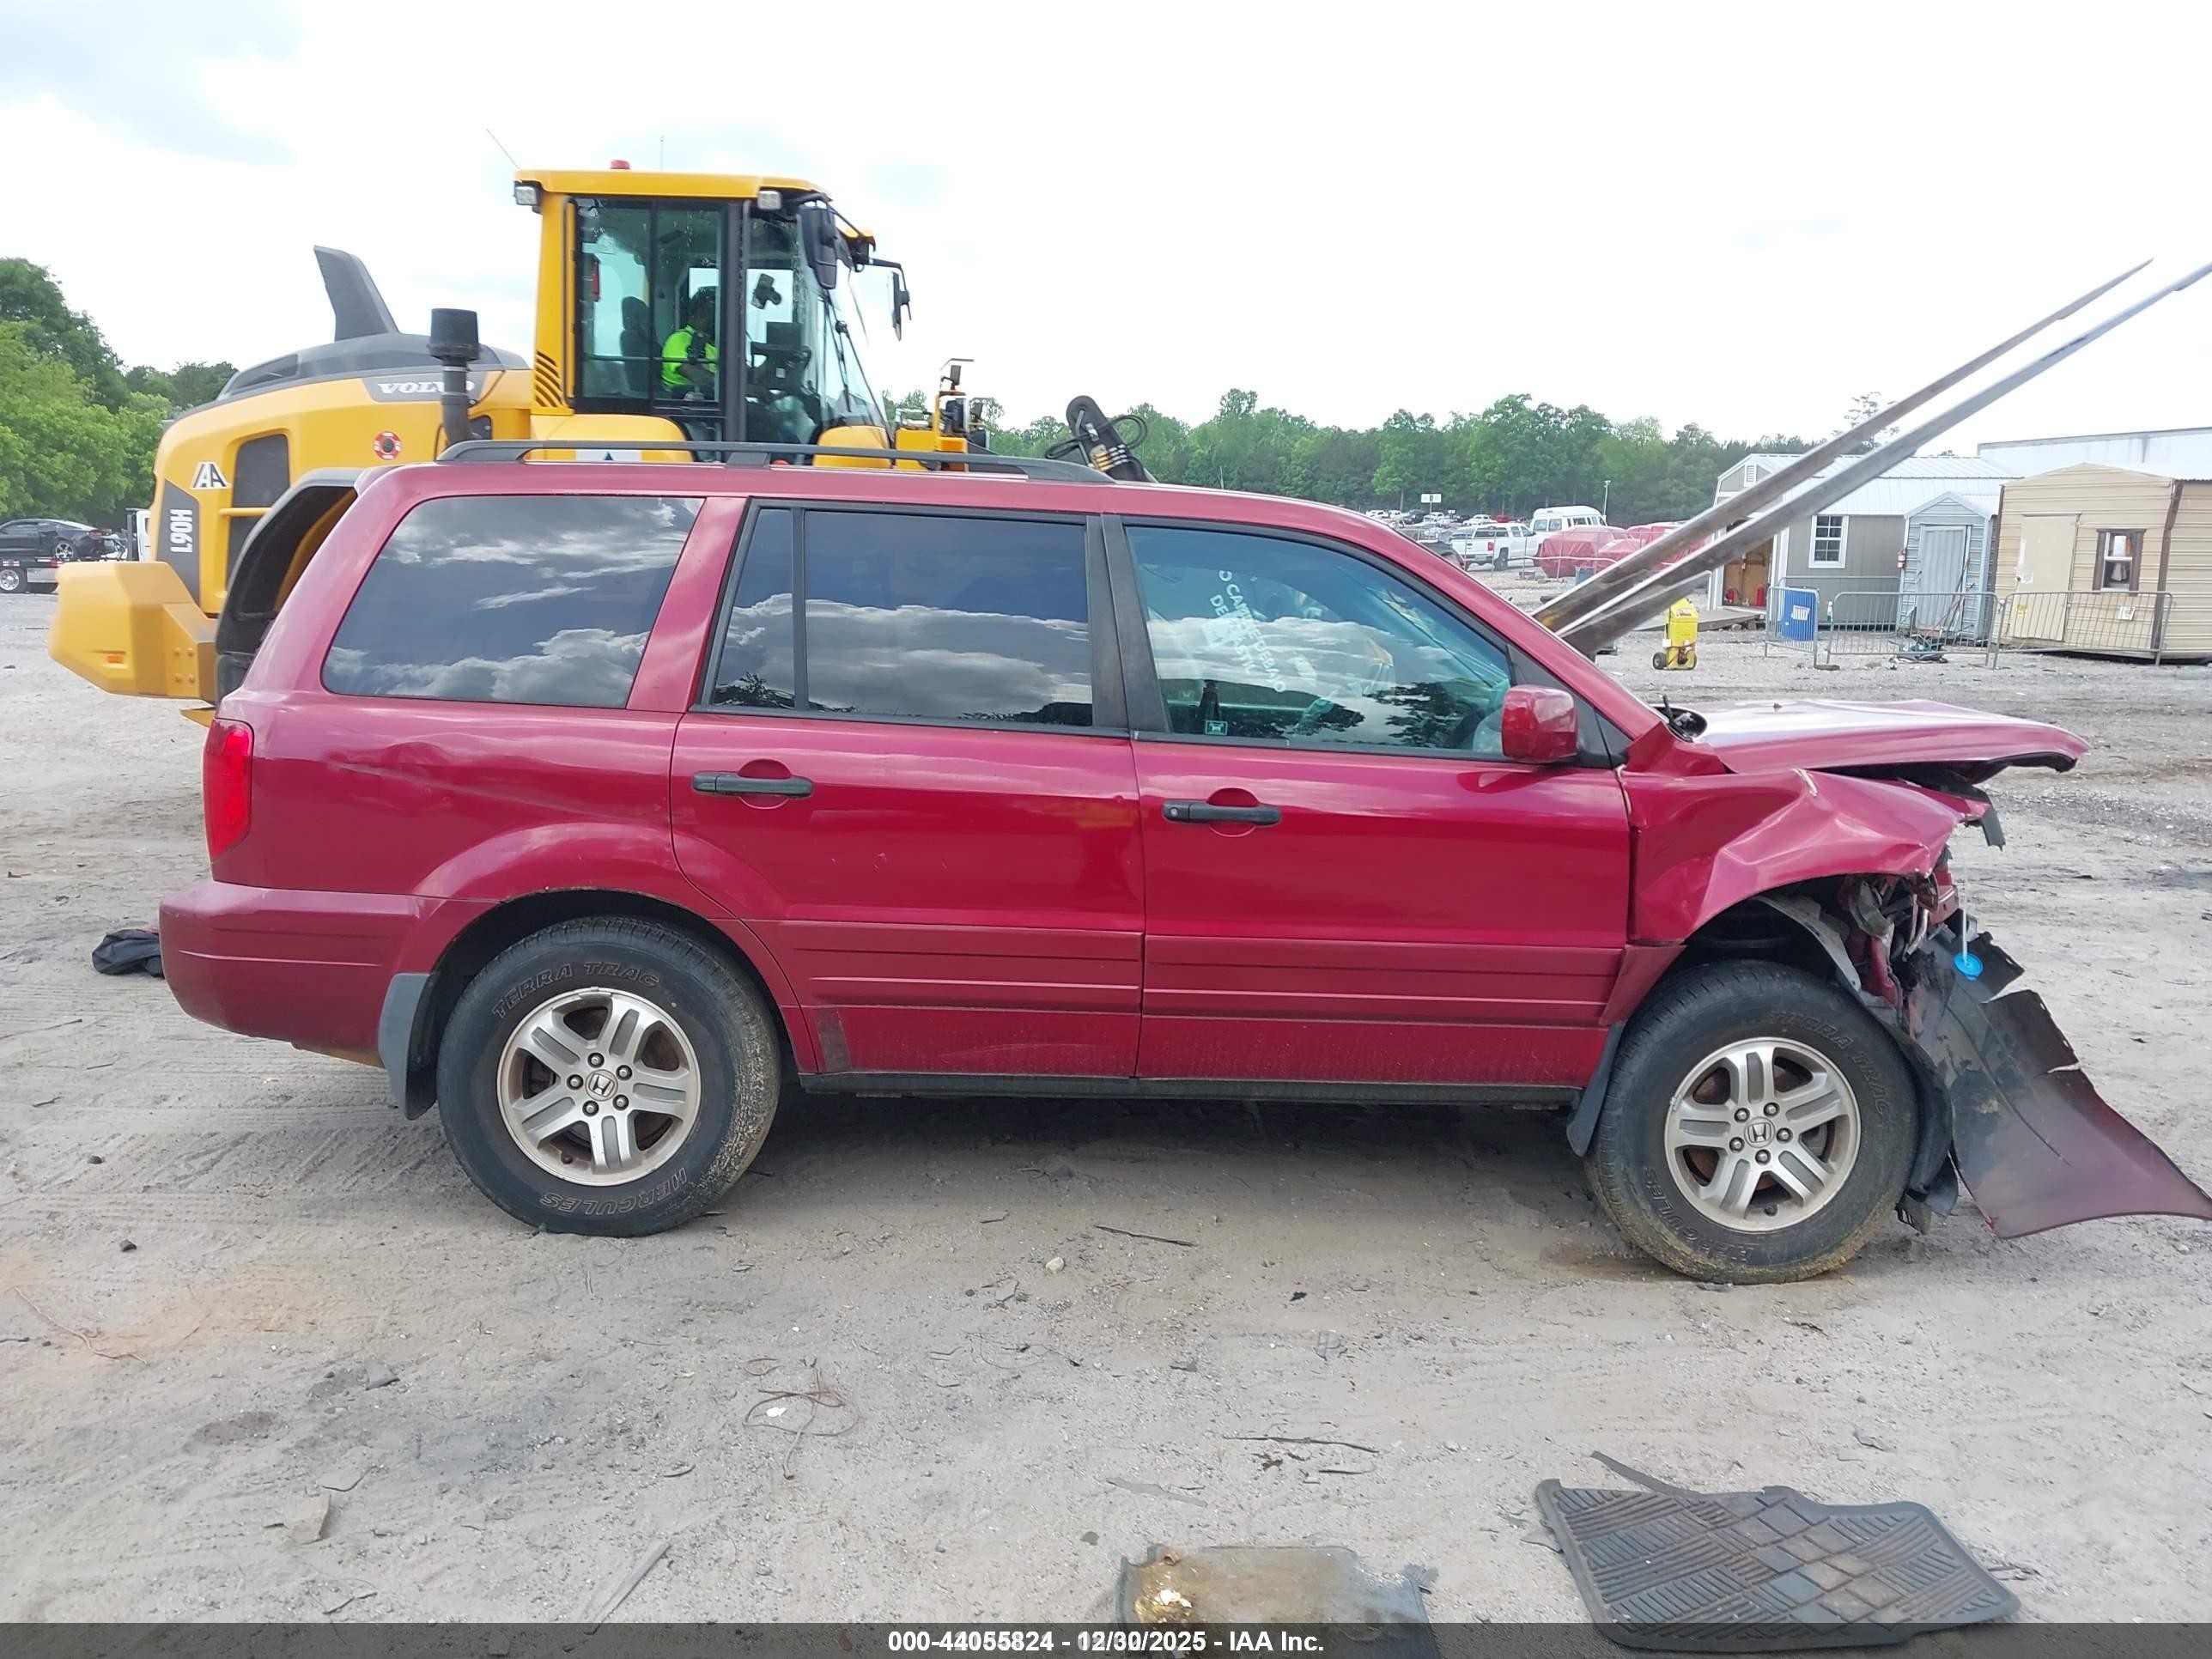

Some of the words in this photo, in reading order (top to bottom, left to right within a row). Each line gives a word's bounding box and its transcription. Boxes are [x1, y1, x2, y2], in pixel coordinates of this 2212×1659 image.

[171, 509, 193, 552] L90H
[1226, 584, 1262, 640] CAME
[492, 963, 574, 1019] TERRA
[584, 961, 659, 988] TRAC
[1769, 1012, 1854, 1049] TERRA
[1850, 1051, 1890, 1115] TRAC
[540, 1167, 688, 1215] HERCULES
